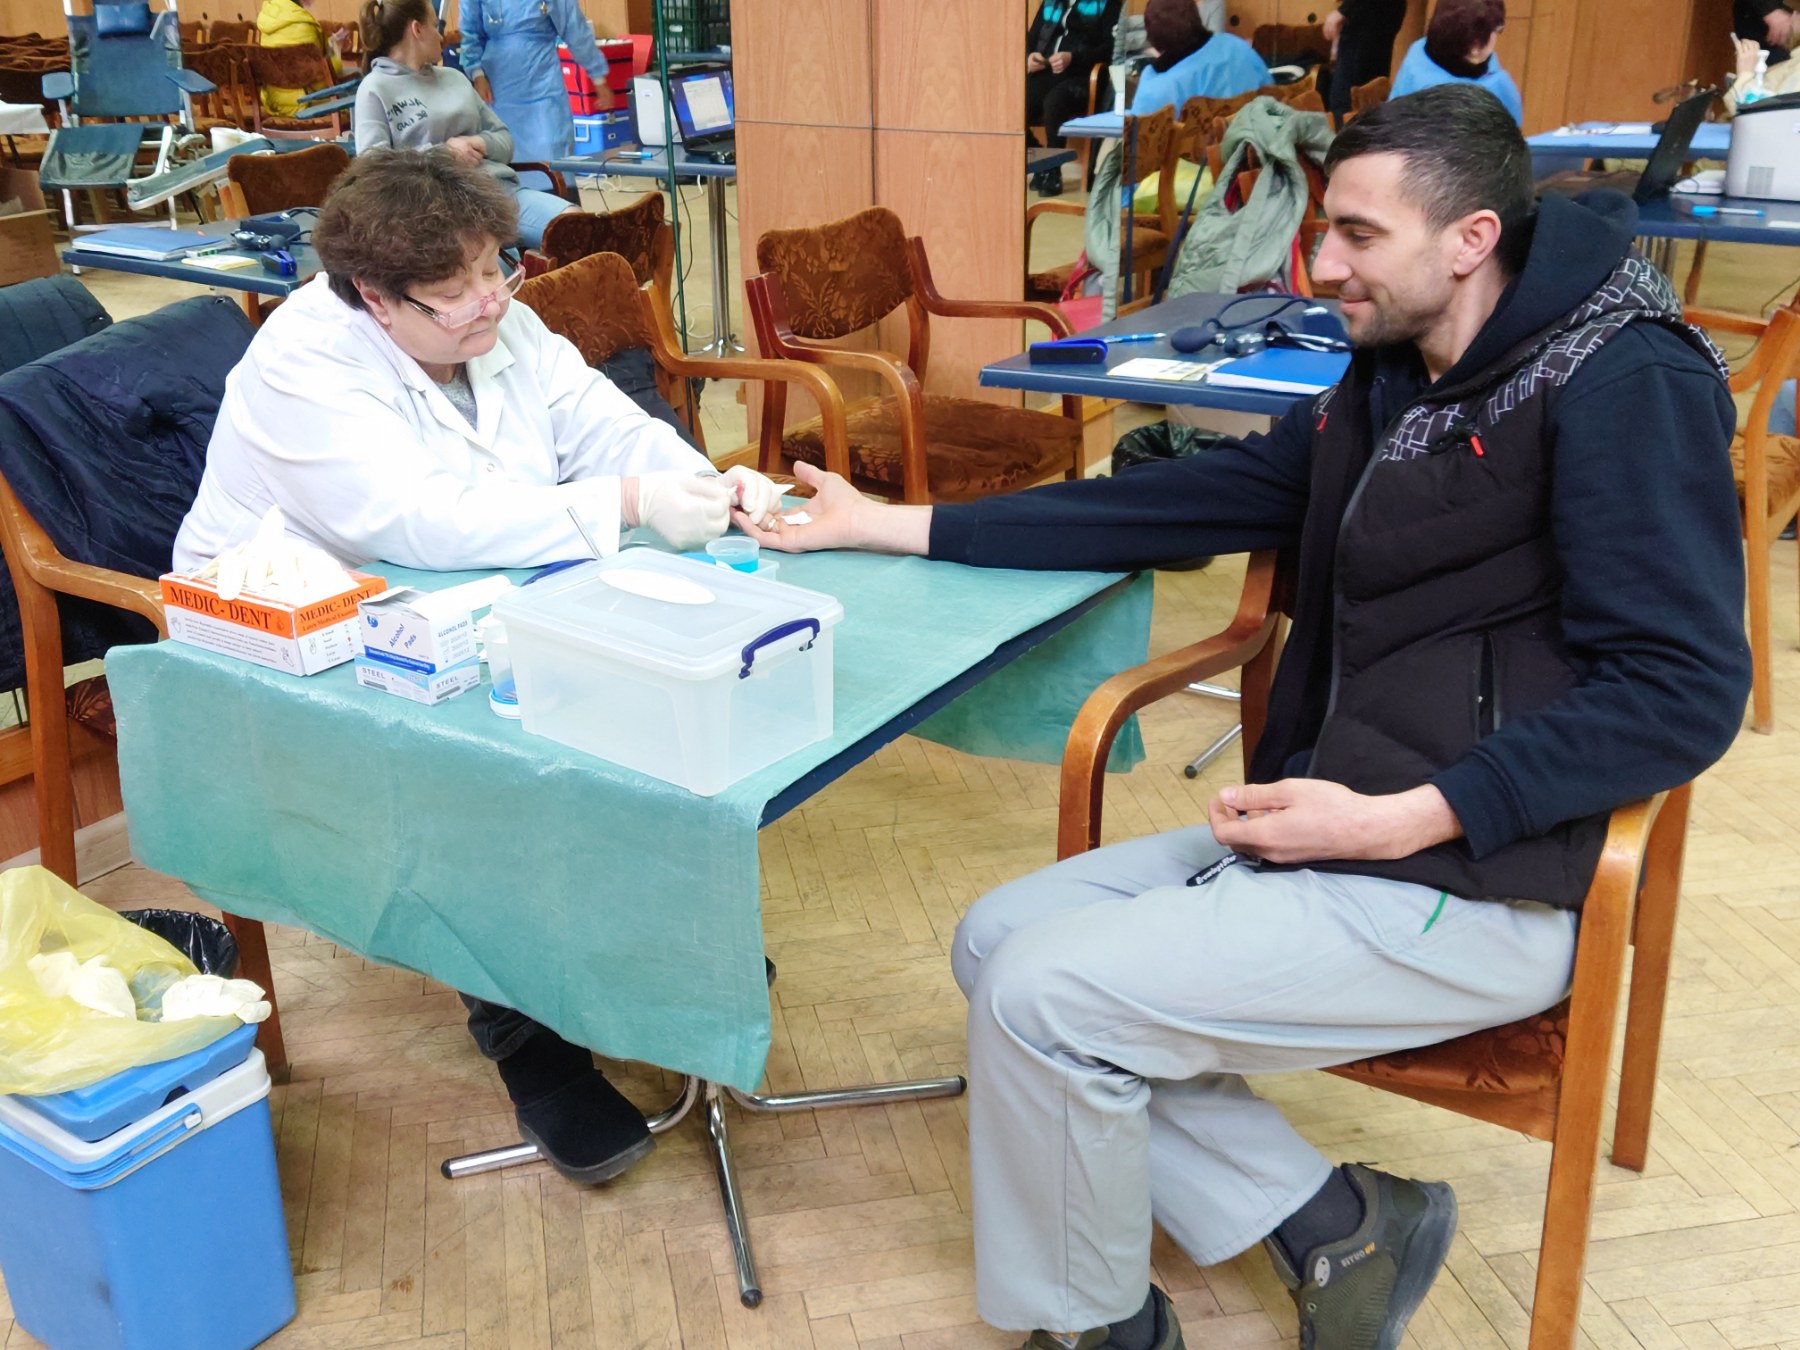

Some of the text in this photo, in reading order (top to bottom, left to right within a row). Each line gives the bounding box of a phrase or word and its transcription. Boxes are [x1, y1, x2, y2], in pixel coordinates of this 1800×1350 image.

[170, 586, 272, 630] MEDIC- DENT
[389, 623, 405, 648] Alcohol
[404, 634, 417, 649] Pads
[362, 667, 386, 679] STEEL
[436, 676, 459, 688] STEEL
